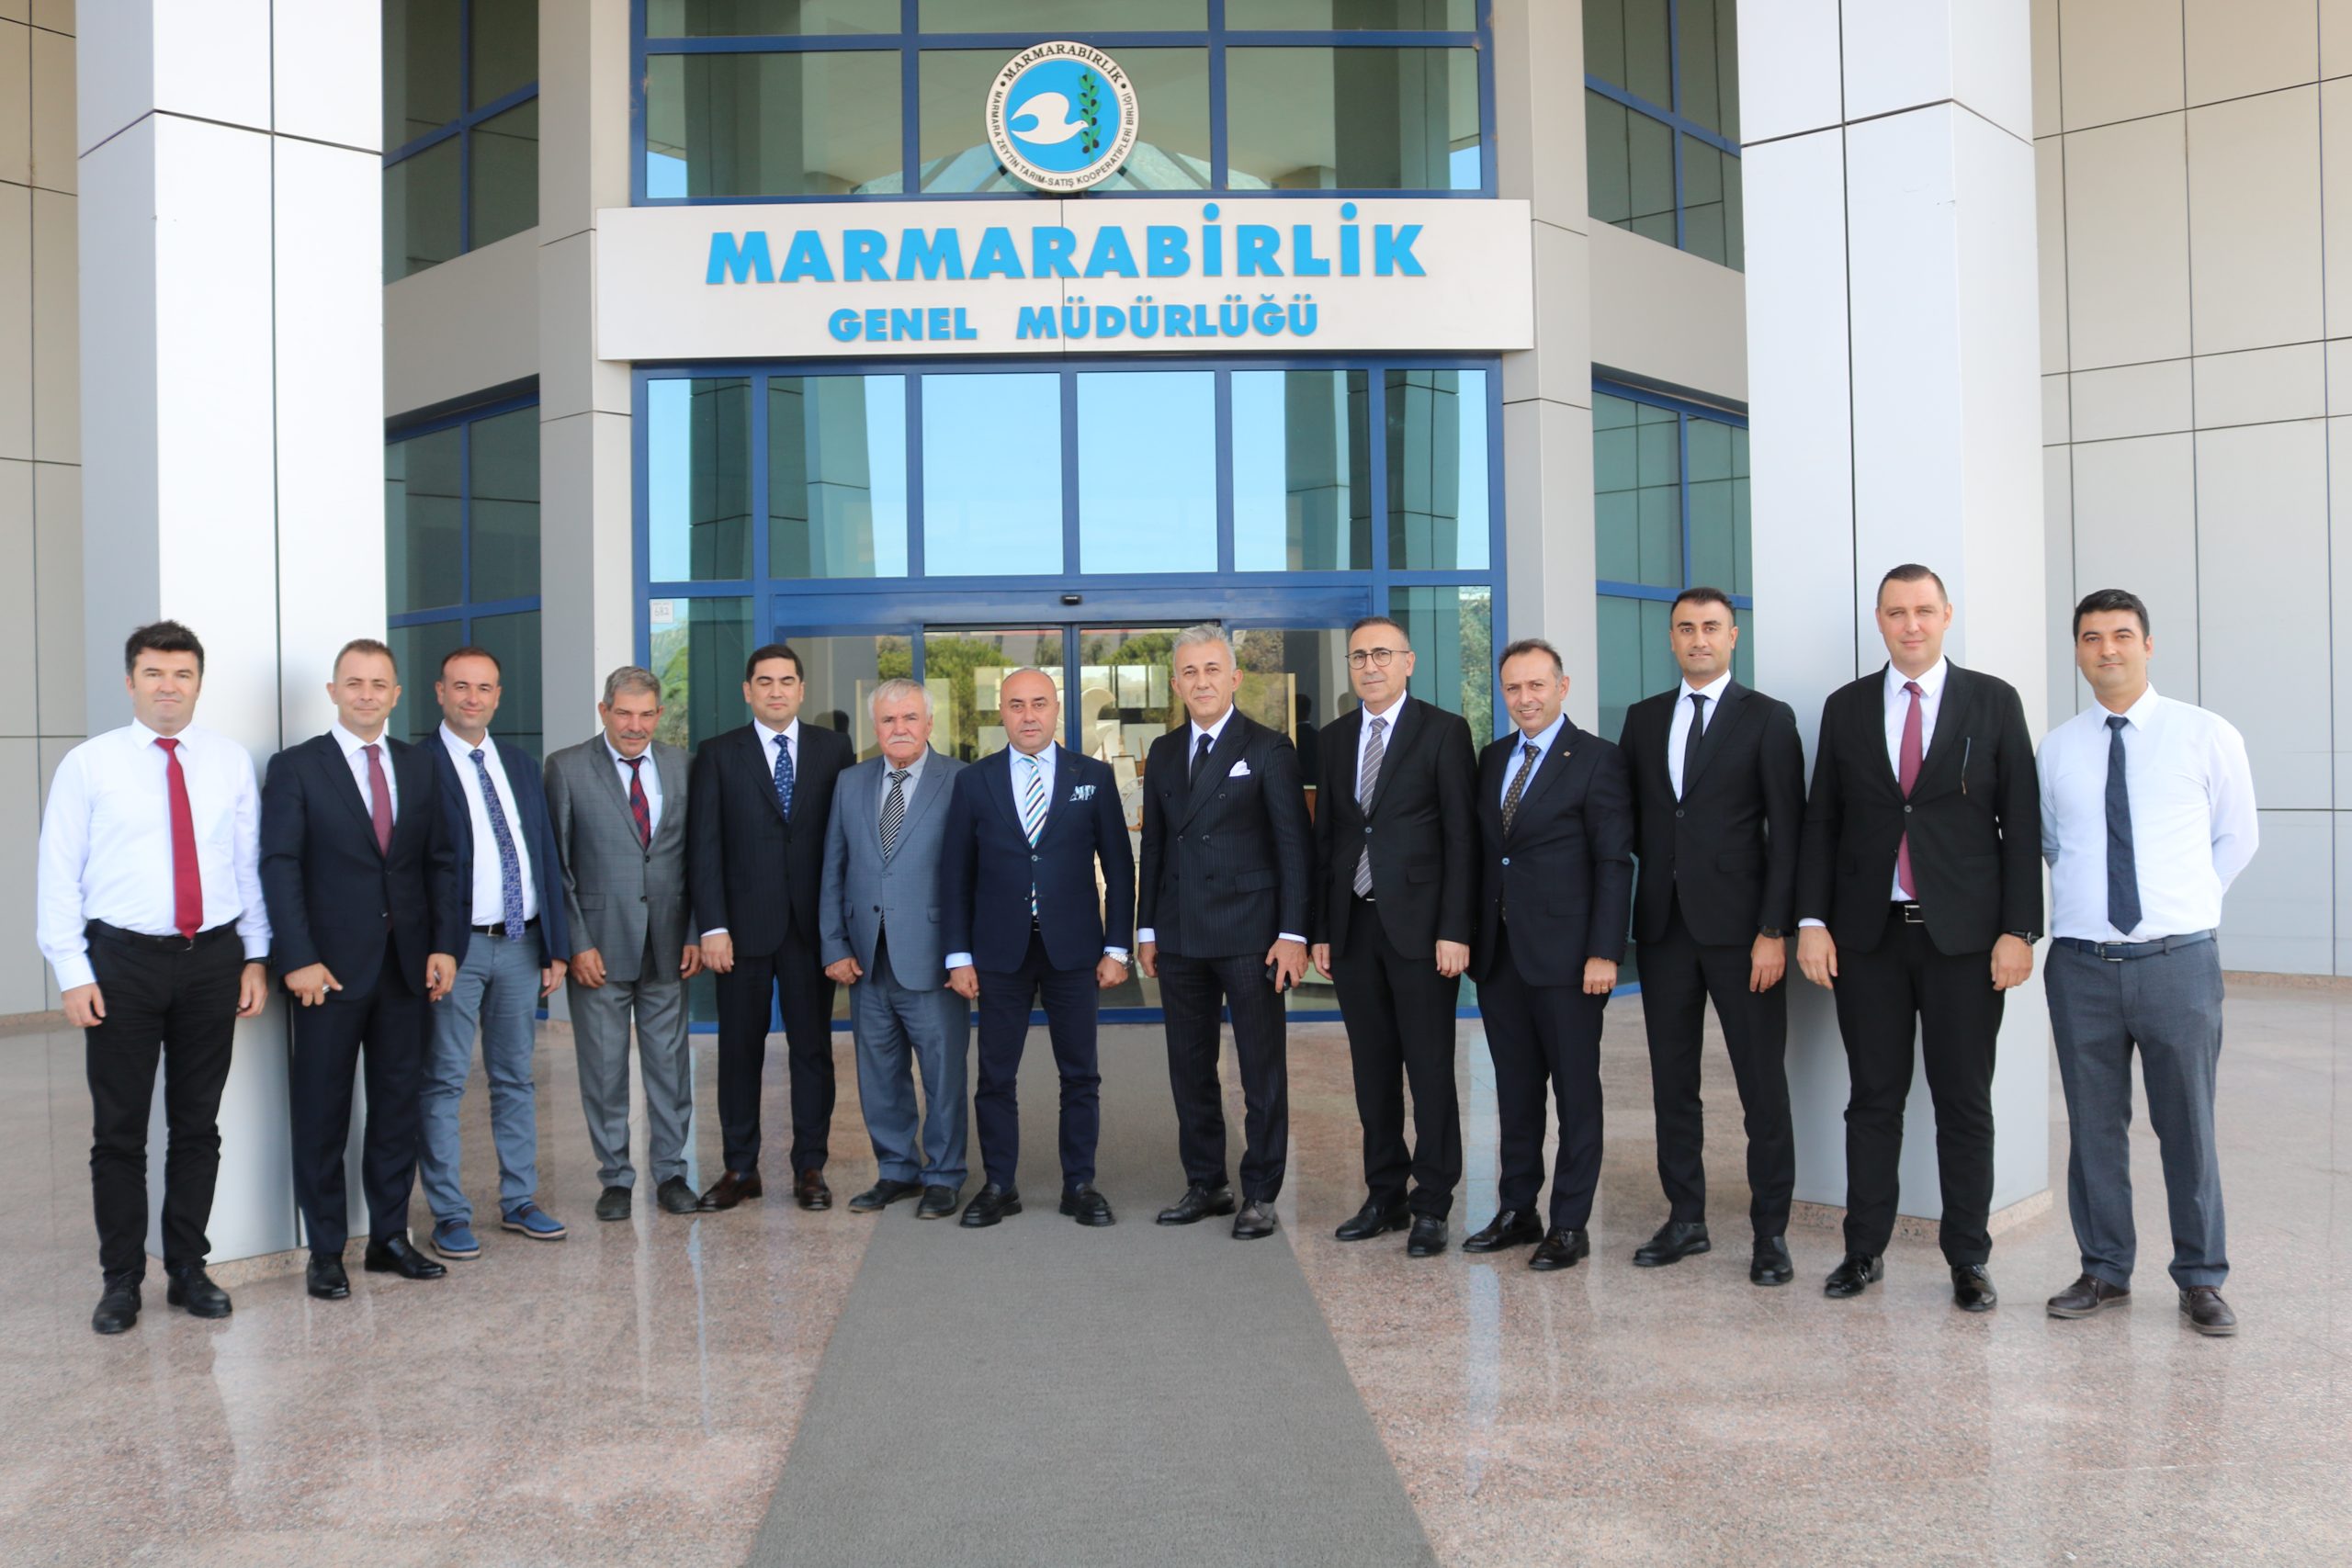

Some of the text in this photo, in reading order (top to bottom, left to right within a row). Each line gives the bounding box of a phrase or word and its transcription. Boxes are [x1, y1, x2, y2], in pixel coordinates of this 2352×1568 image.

[1003, 43, 1123, 85] MARMARABİRLİK
[991, 90, 1003, 138] MARMARA
[997, 139, 1022, 168] ZEYTİN
[706, 201, 1425, 284] MARMARABİRLİK
[829, 294, 1317, 342] GENEL MÜDÜRLÜĞÜ
